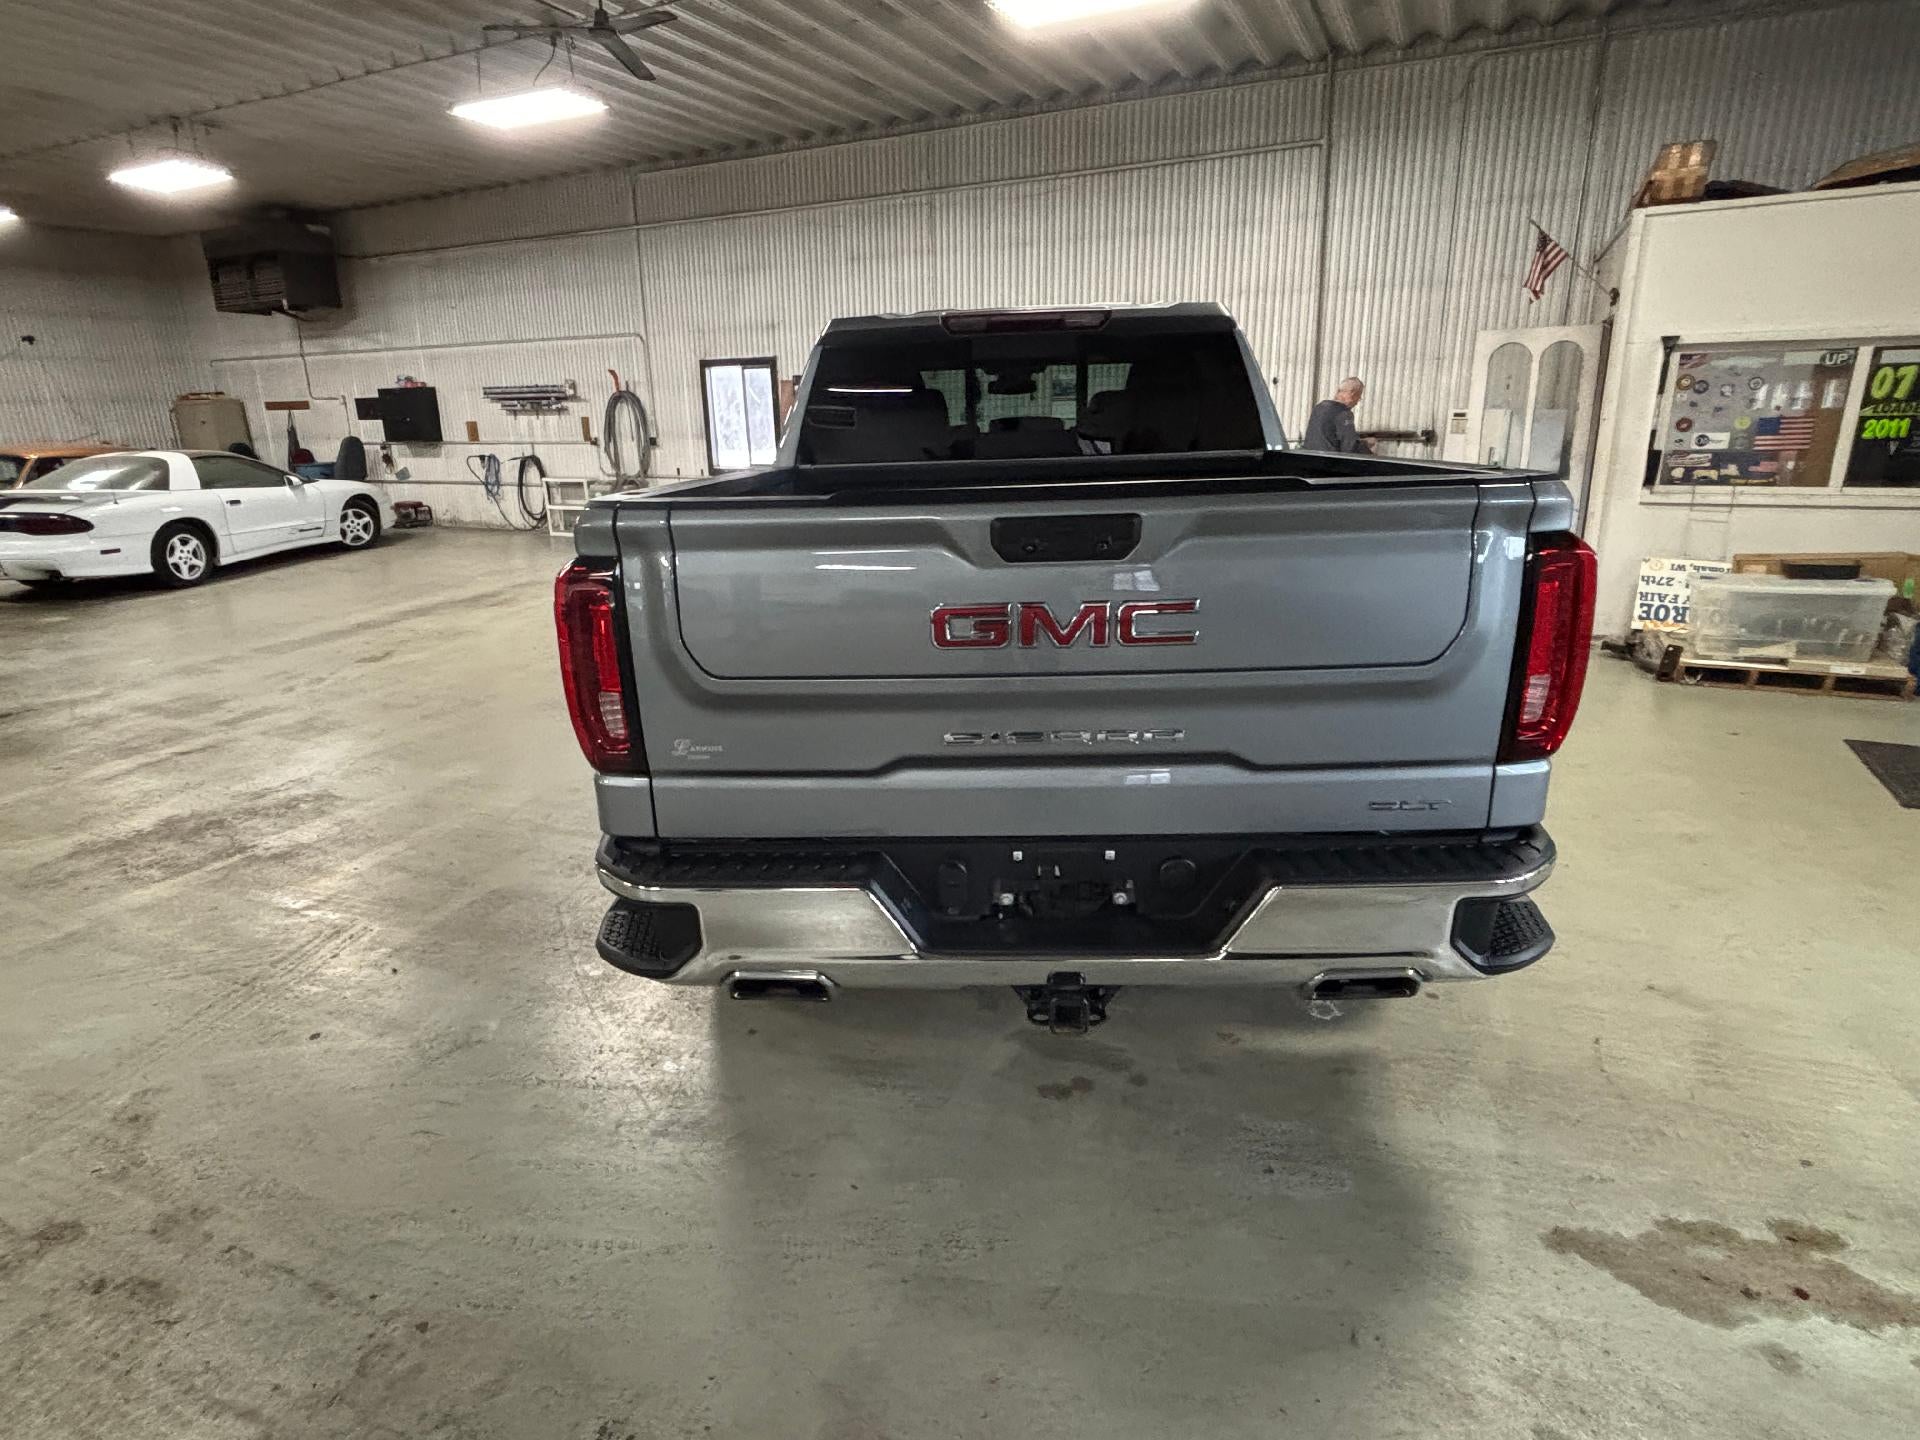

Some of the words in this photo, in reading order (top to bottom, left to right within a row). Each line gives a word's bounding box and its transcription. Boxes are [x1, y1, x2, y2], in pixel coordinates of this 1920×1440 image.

[1825, 352, 1849, 365] UP
[1870, 364, 1919, 399] 07
[1861, 417, 1912, 440] 2011
[1670, 563, 1687, 572] WI
[1641, 575, 1675, 587] 27th
[1639, 591, 1680, 604] FAIR
[930, 598, 1200, 650] GMC
